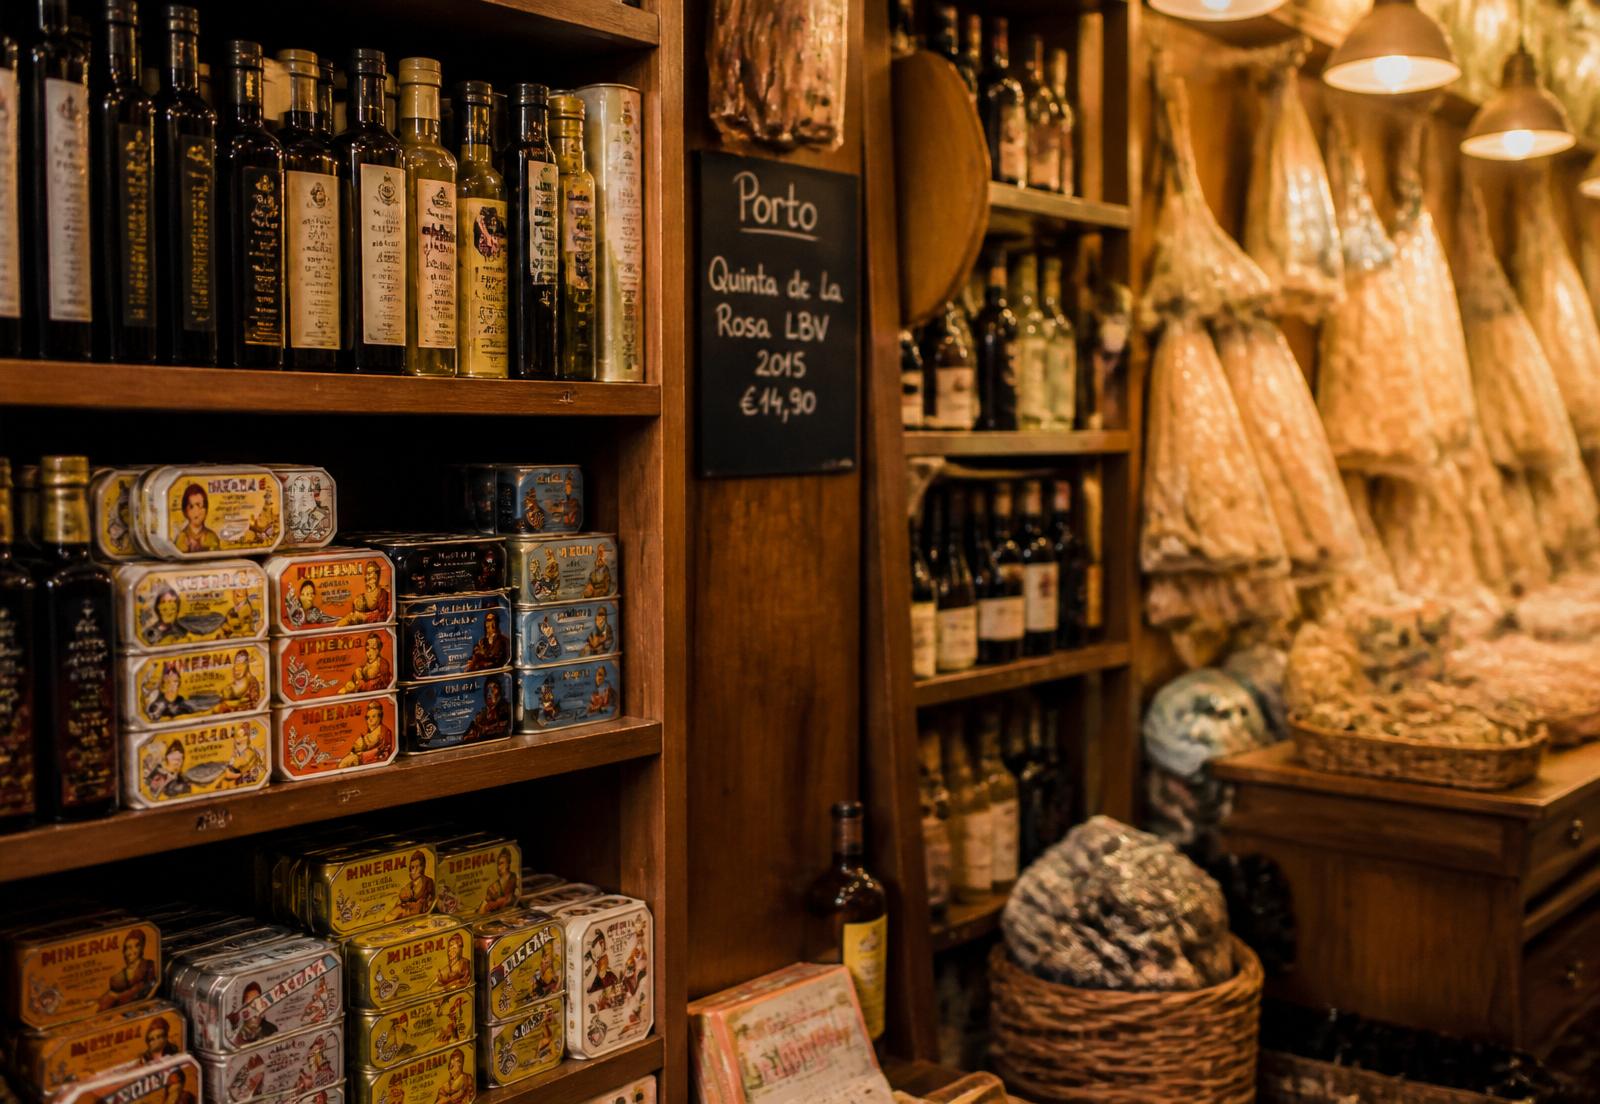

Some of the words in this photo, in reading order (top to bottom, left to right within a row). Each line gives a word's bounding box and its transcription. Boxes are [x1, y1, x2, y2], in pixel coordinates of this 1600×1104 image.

[732, 171, 818, 231] Porto
[708, 255, 779, 297] Quinta
[787, 269, 811, 299] de
[716, 302, 772, 338] Rosa
[785, 311, 830, 342] LBV
[755, 350, 807, 378] 2015
